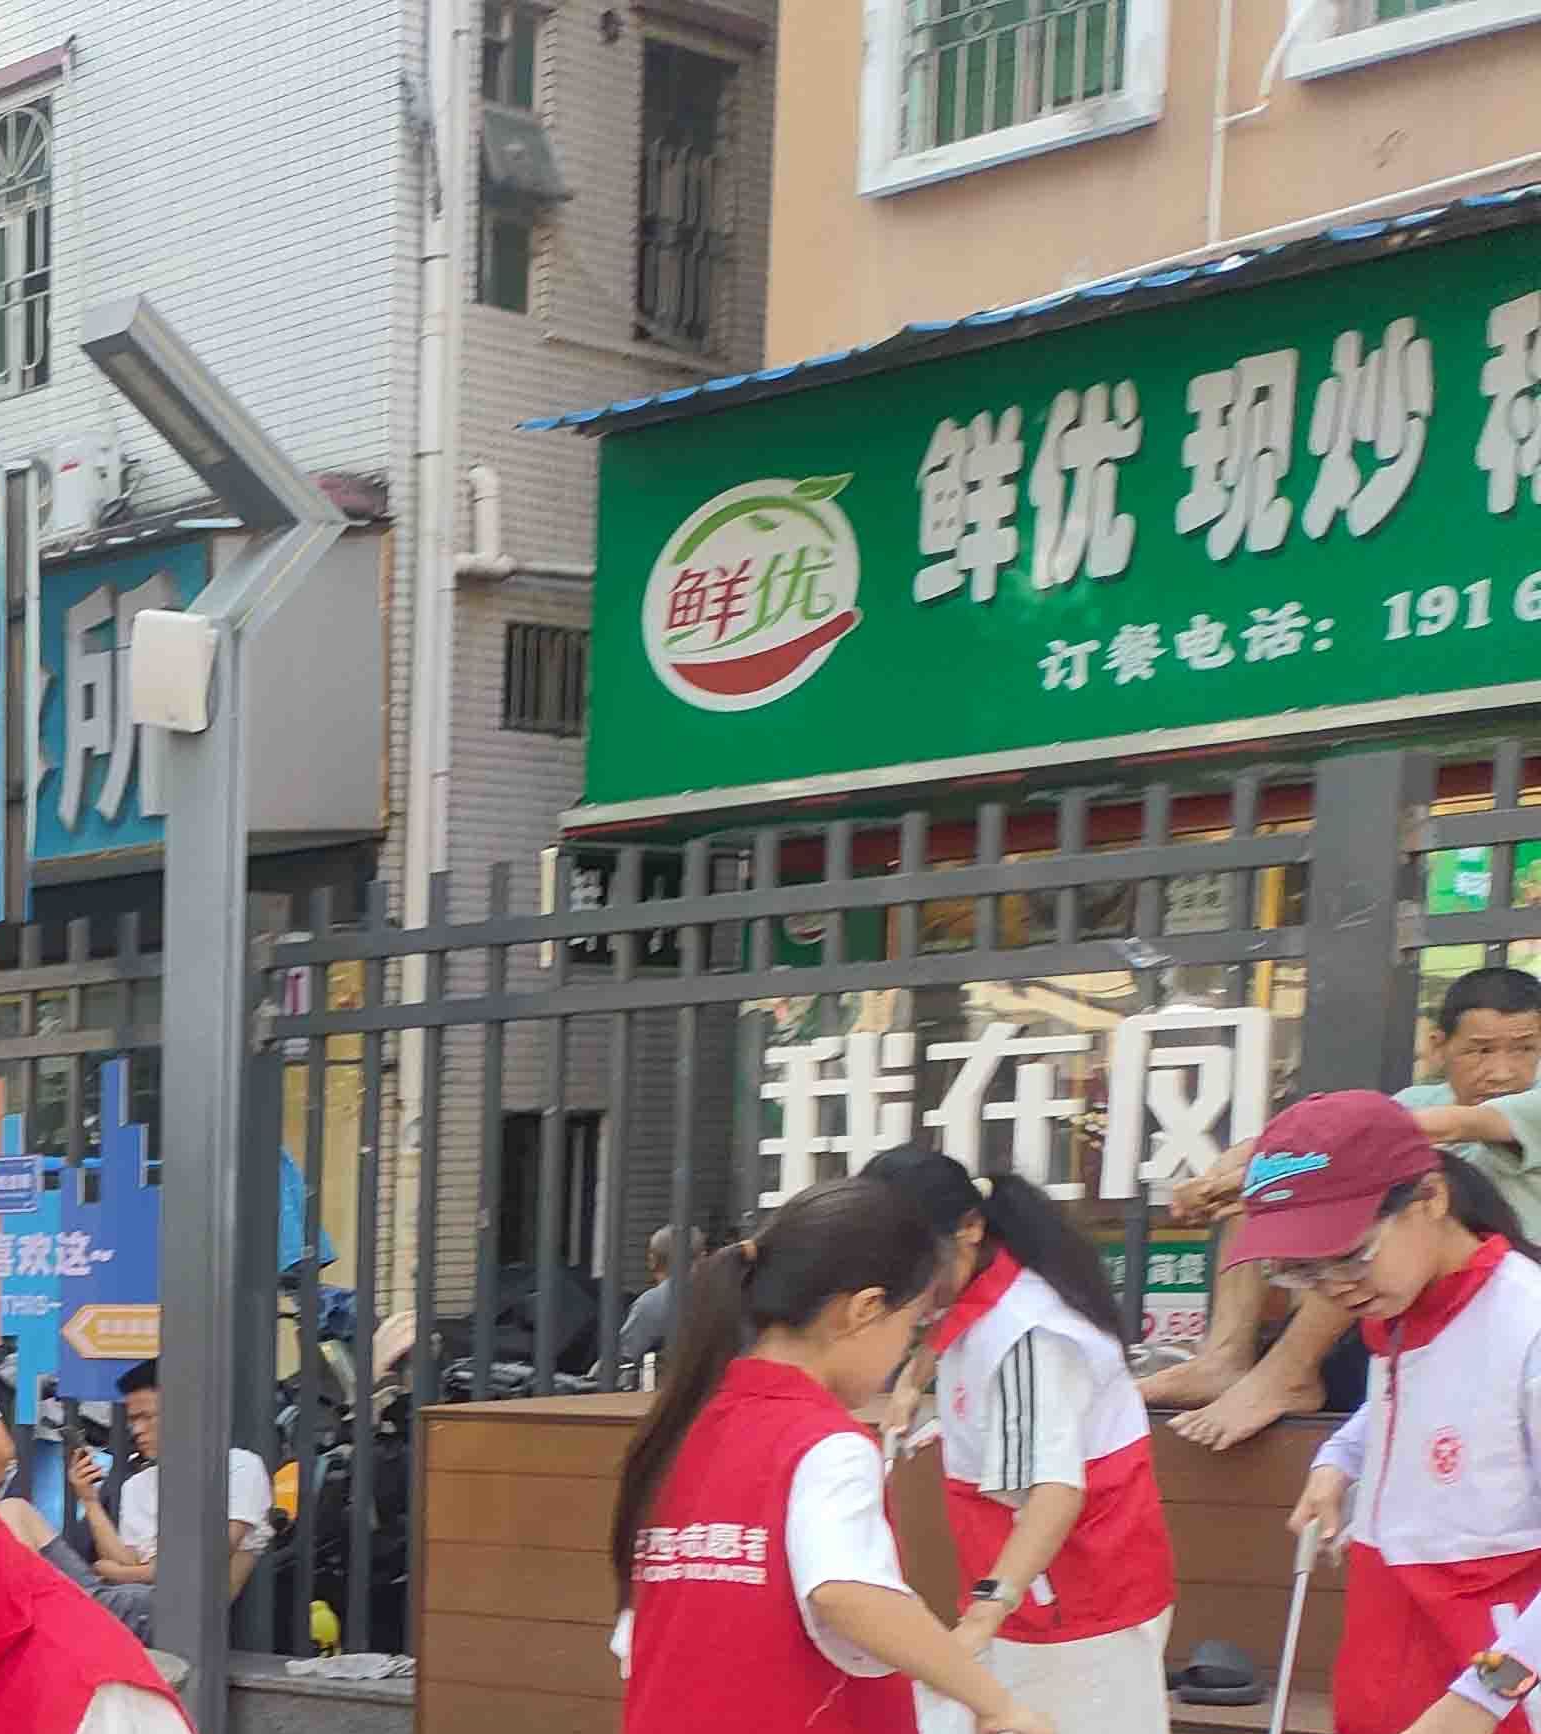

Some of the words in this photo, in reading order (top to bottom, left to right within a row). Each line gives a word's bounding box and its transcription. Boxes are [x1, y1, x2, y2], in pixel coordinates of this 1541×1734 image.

[913, 378, 1143, 604] 鲜优
[1175, 317, 1435, 562] 现炒
[665, 545, 837, 655] 鲜优
[1383, 578, 1493, 641] 191
